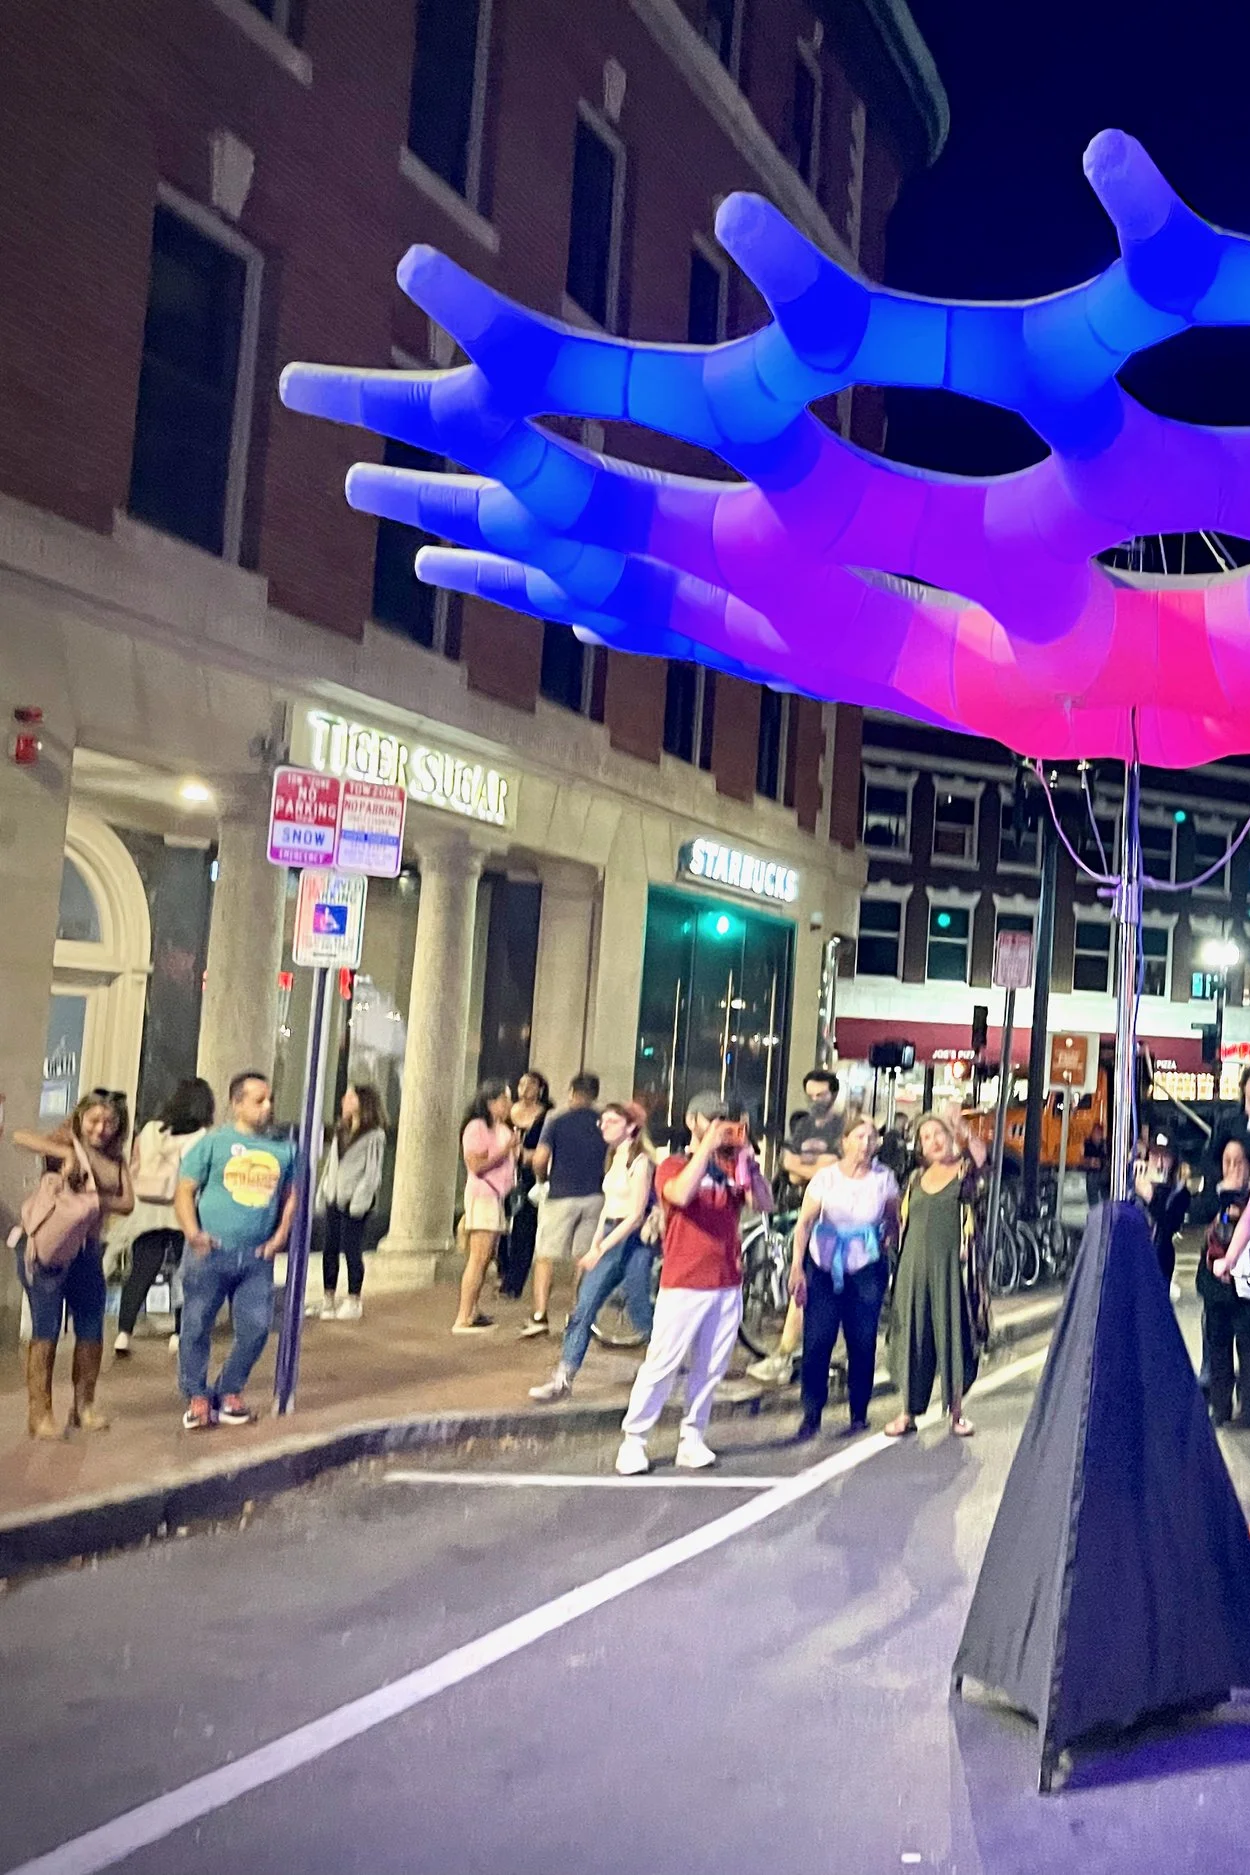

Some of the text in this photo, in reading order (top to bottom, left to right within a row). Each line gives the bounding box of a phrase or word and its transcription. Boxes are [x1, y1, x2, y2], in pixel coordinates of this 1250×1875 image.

[308, 710, 507, 825] TIGER SUGAR
[298, 785, 317, 801] NO
[349, 781, 398, 801] TOW ZONE
[275, 795, 336, 821] PARKING
[344, 799, 400, 818] NO PARKING
[282, 827, 325, 847] SNOW
[690, 838, 796, 902] STARBUCKS
